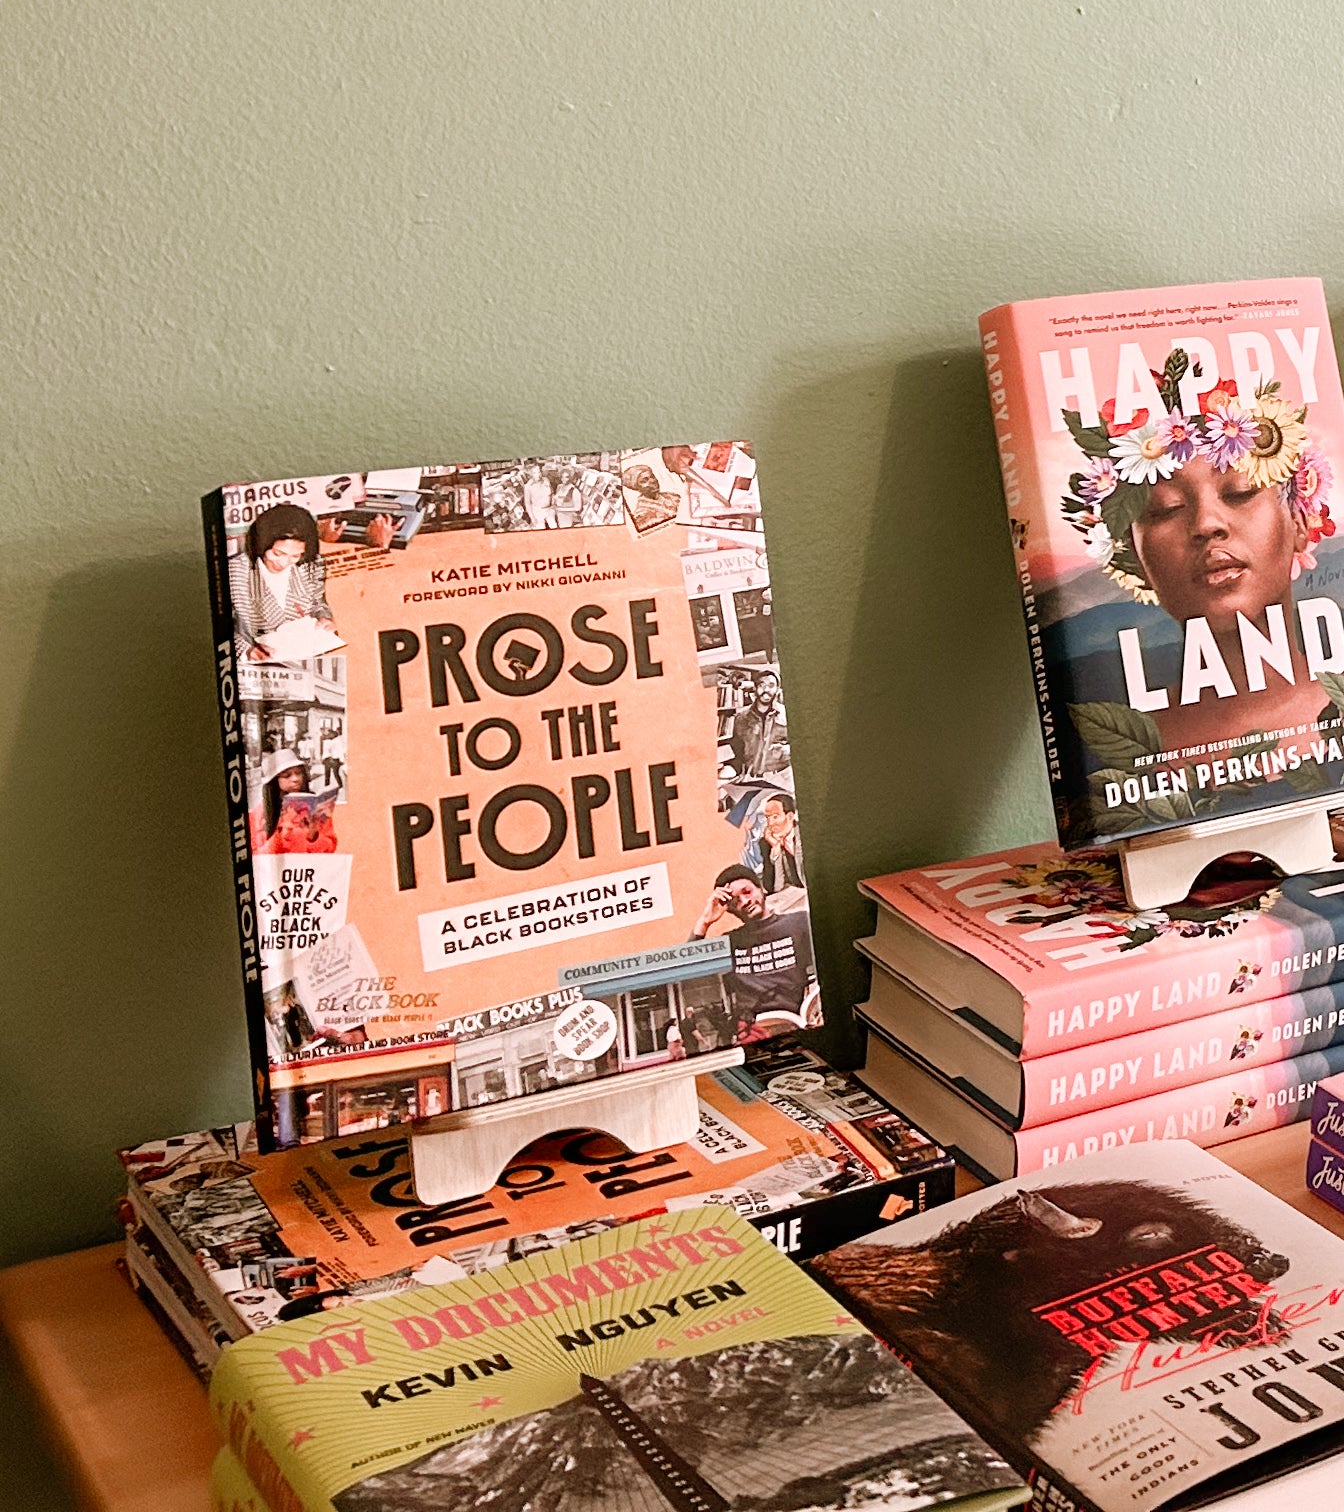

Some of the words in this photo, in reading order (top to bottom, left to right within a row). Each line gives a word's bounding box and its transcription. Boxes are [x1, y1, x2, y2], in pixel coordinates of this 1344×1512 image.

[1039, 327, 1321, 432] HAPPY
[404, 585, 488, 603] FOREWORD
[517, 577, 554, 591] NIKKI
[558, 569, 626, 586] GIOVANNI
[431, 565, 491, 583] KATIE
[498, 554, 598, 576] MITCHELL
[685, 555, 753, 574] BALDWIN
[378, 598, 664, 715] PROSE
[439, 718, 521, 776] TO
[542, 701, 621, 761] THE
[1156, 750, 1179, 763] YORK
[1207, 735, 1261, 753] BESTSELLING
[1263, 728, 1295, 742] AUTHOR
[1105, 769, 1189, 808] DOLEN
[392, 762, 683, 891] PEOPLE
[259, 884, 338, 913] STORIES
[282, 868, 315, 883] OUR
[270, 917, 321, 933] BLACK
[281, 901, 313, 916] ARE
[441, 921, 456, 935] A
[463, 884, 617, 930] CELEBRATION
[624, 877, 651, 894] OF
[443, 928, 512, 955] BLACK
[520, 897, 654, 938] BOOKSTORES
[564, 956, 641, 981] COMMUNITY
[645, 951, 678, 965] BOOK
[679, 940, 727, 959] CENTER
[1047, 989, 1140, 1038] HAPPY
[1152, 972, 1222, 1014] LAND
[1271, 951, 1323, 977] DOLEN
[272, 1317, 378, 1387] MY
[390, 1223, 750, 1353] DOCUMENTS
[1040, 1251, 1245, 1335] BUFFALO
[1066, 1272, 1277, 1357] HUNTER
[358, 1352, 515, 1411] KEVIN
[553, 1279, 749, 1353] NGUYEN
[1161, 1349, 1310, 1412] STEPHEN
